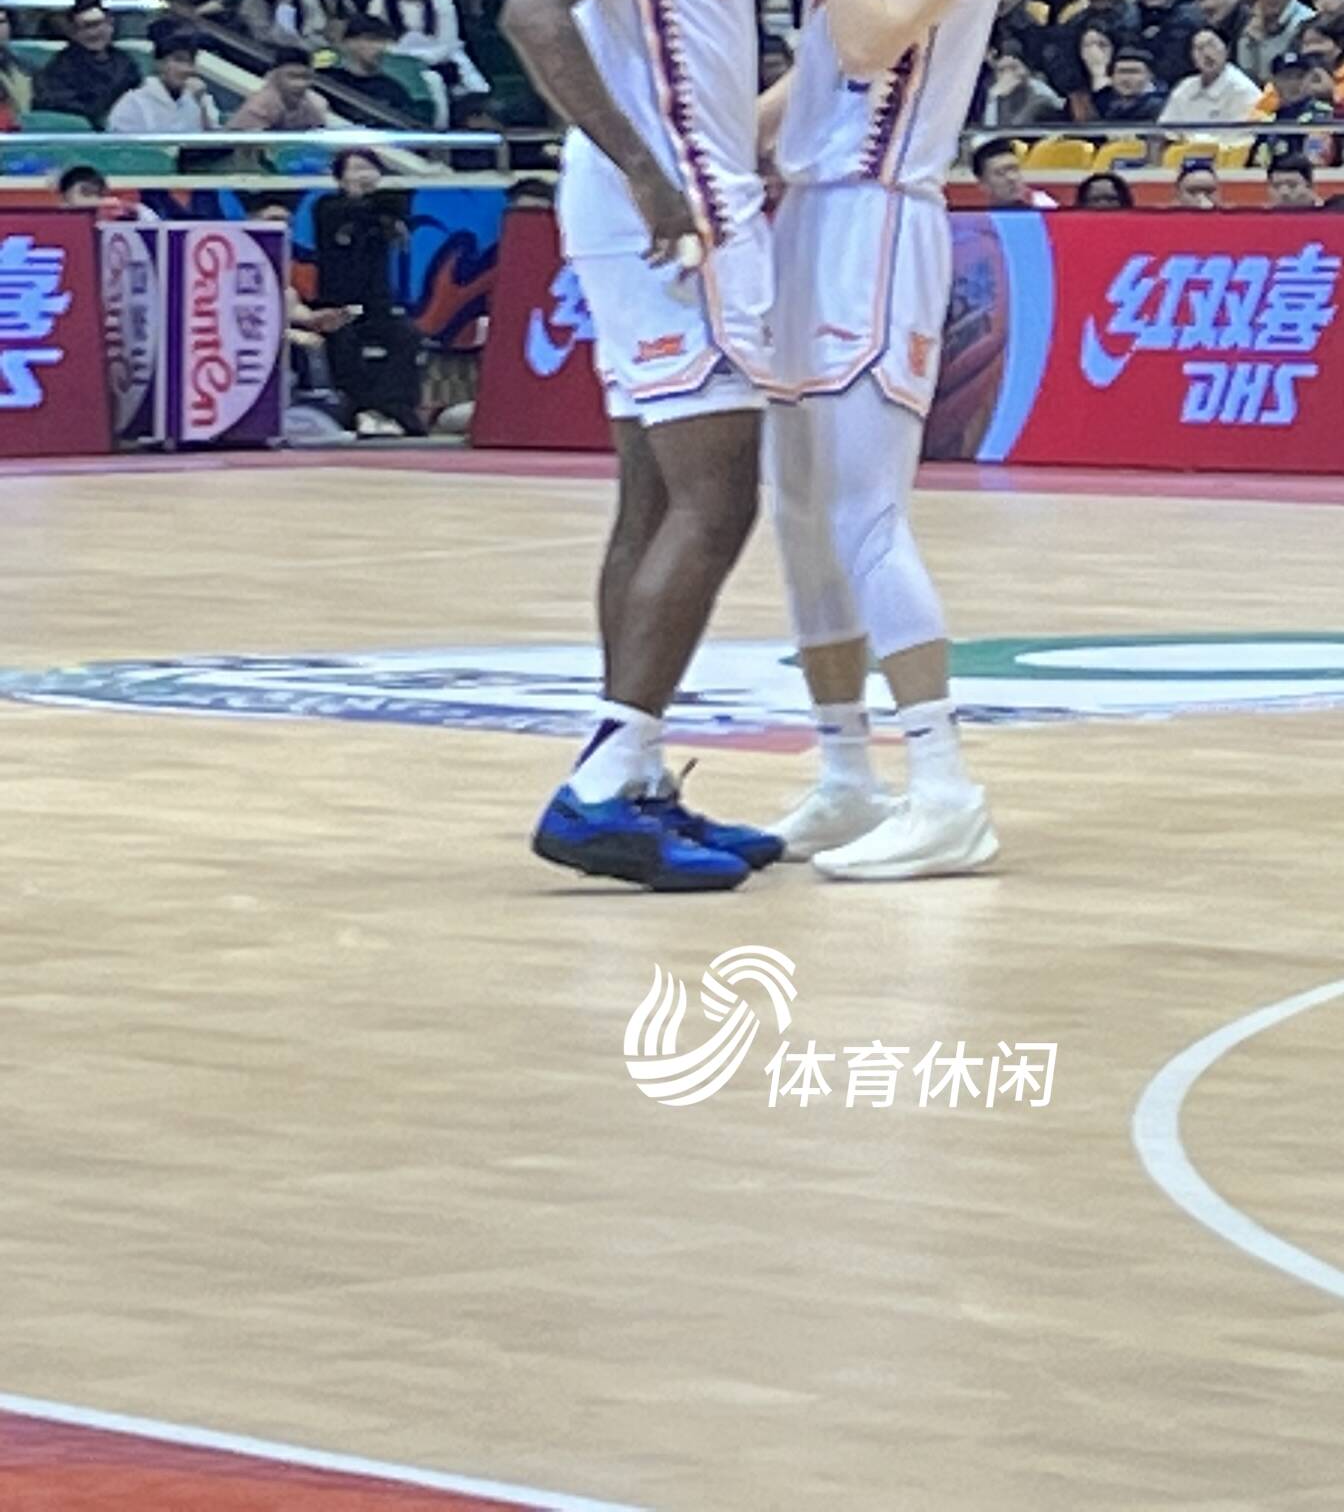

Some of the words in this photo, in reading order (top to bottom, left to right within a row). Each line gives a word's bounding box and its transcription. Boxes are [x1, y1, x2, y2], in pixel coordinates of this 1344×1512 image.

[1107, 241, 1342, 351] 红双喜
[1180, 362, 1319, 424] DHS
